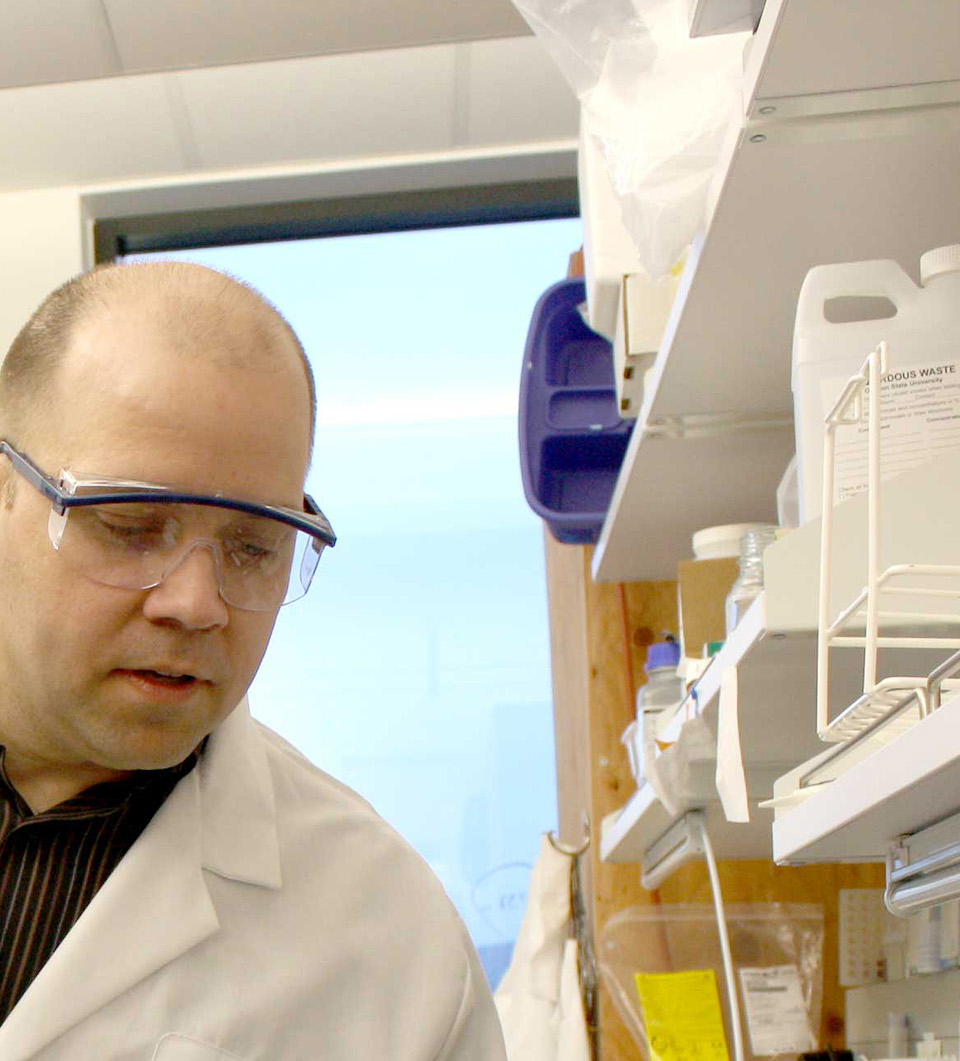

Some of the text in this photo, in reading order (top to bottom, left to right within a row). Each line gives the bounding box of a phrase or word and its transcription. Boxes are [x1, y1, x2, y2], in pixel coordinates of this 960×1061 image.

[919, 365, 956, 377] WASTE
[891, 381, 908, 390] State
[909, 377, 943, 388] University
